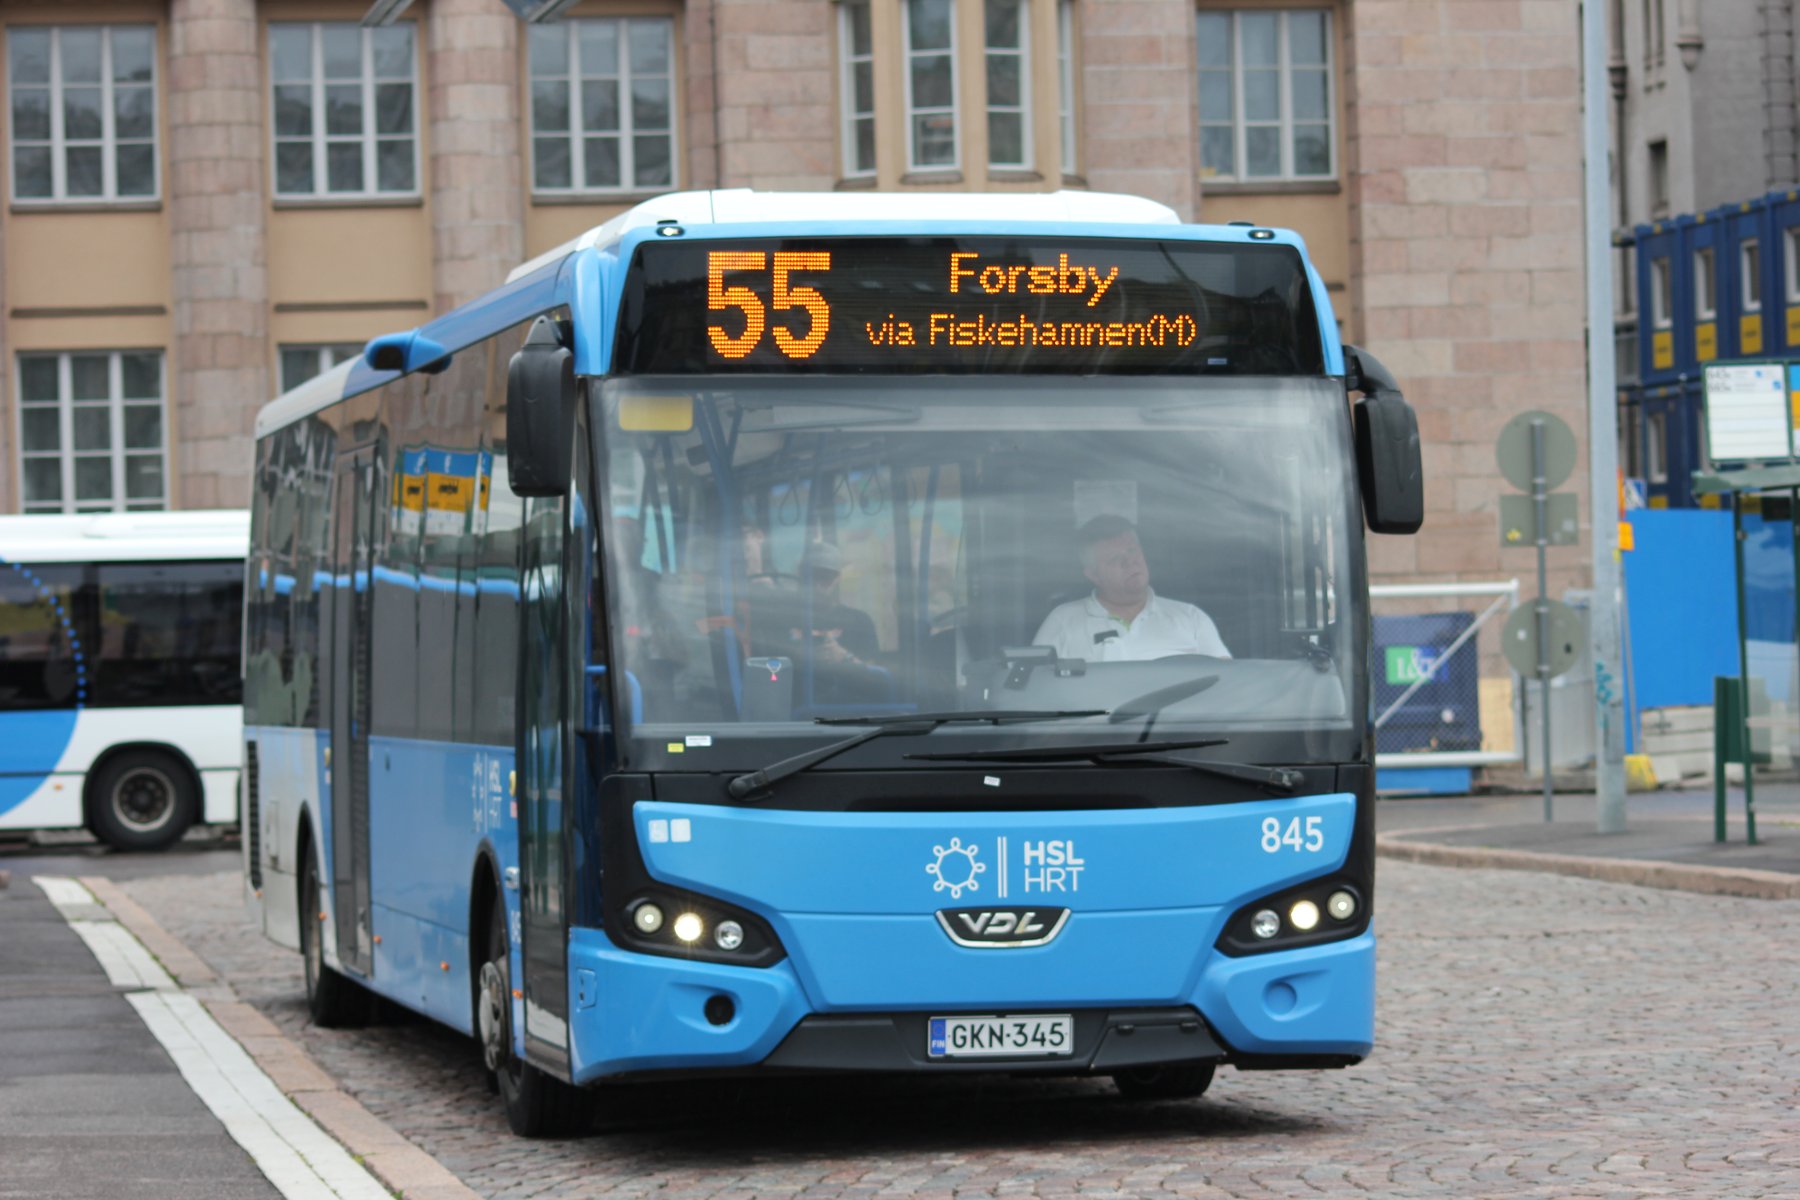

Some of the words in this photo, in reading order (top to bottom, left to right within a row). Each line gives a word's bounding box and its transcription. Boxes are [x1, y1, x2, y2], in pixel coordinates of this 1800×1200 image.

[949, 252, 1119, 307] Forsby
[707, 250, 831, 359] 55
[865, 313, 916, 346] via
[929, 313, 1197, 347] Fiskehamnen(M)
[1261, 816, 1324, 853] 845
[1024, 840, 1085, 866] HSL
[1024, 866, 1085, 892] HRT
[958, 912, 1044, 935] VDL
[932, 1039, 945, 1049] FIN
[952, 1022, 1065, 1049] GKN-345
